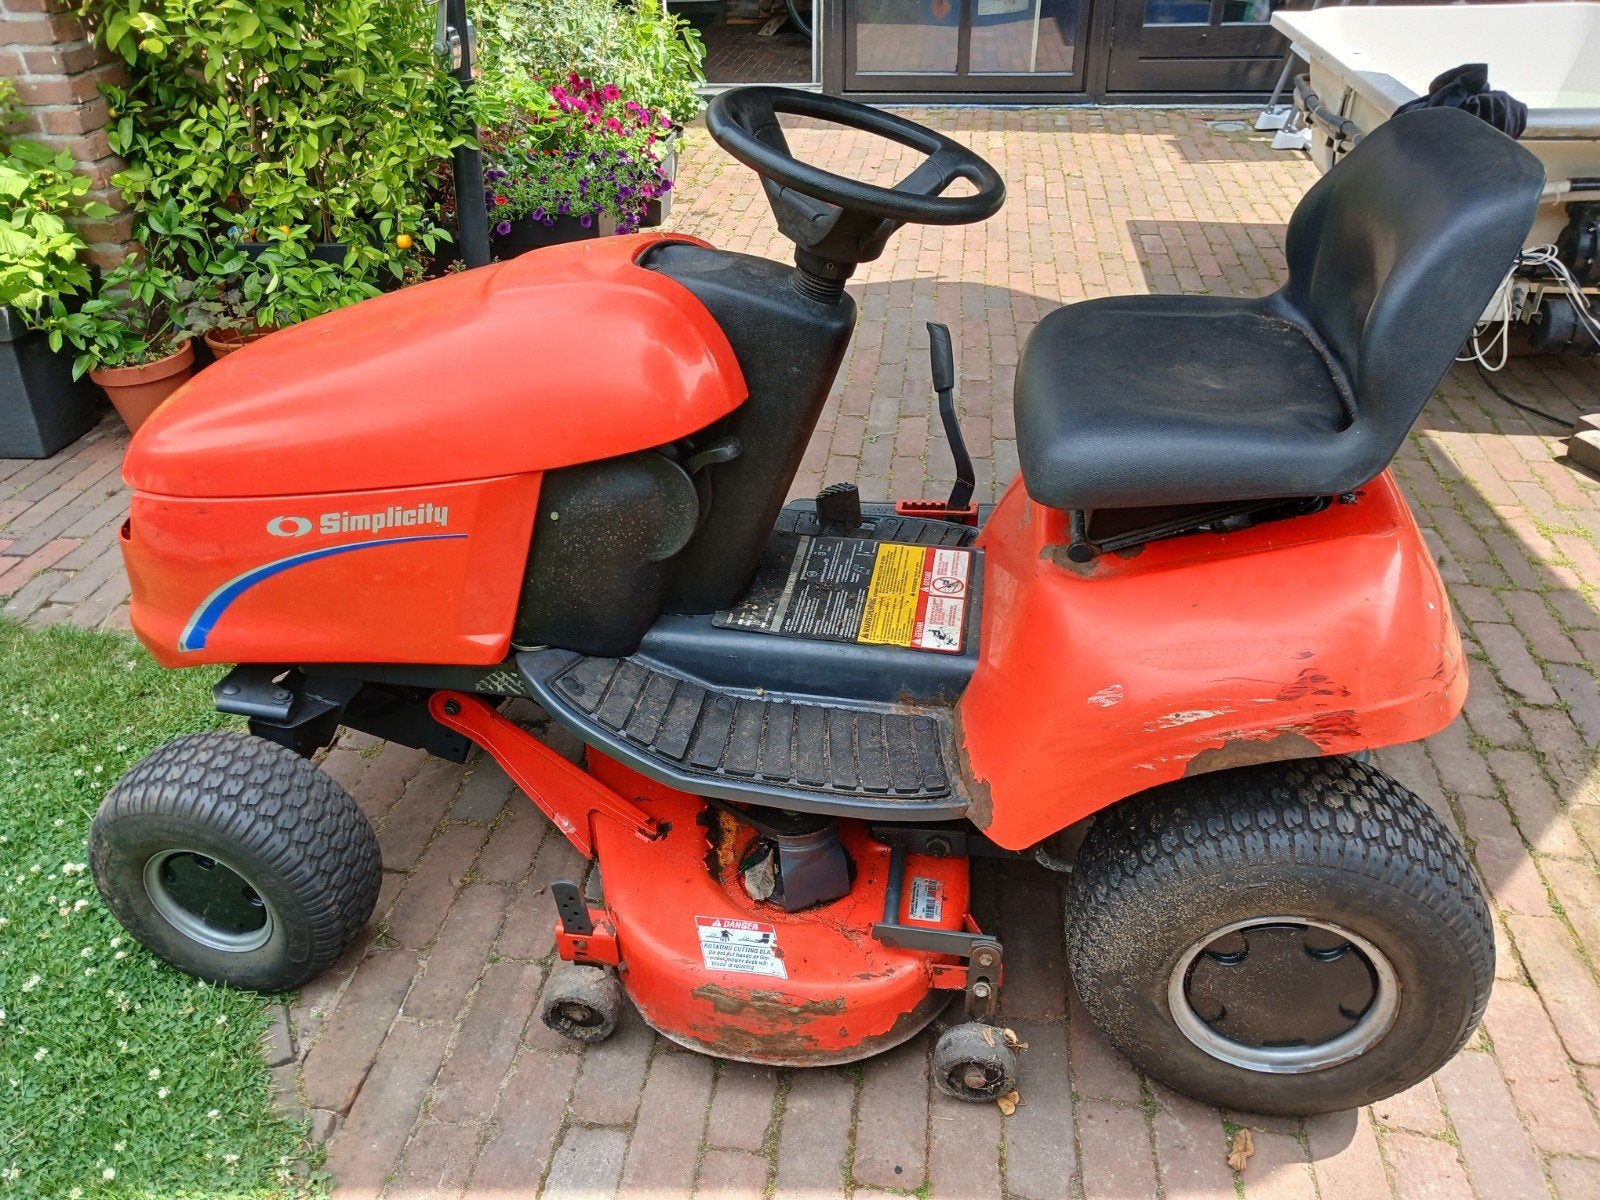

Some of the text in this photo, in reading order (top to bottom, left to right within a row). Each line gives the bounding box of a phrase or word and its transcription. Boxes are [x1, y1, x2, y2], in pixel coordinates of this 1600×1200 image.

[319, 502, 449, 535] Simplicity
[723, 920, 760, 931] DANGER
[704, 943, 733, 951] ROTATING
